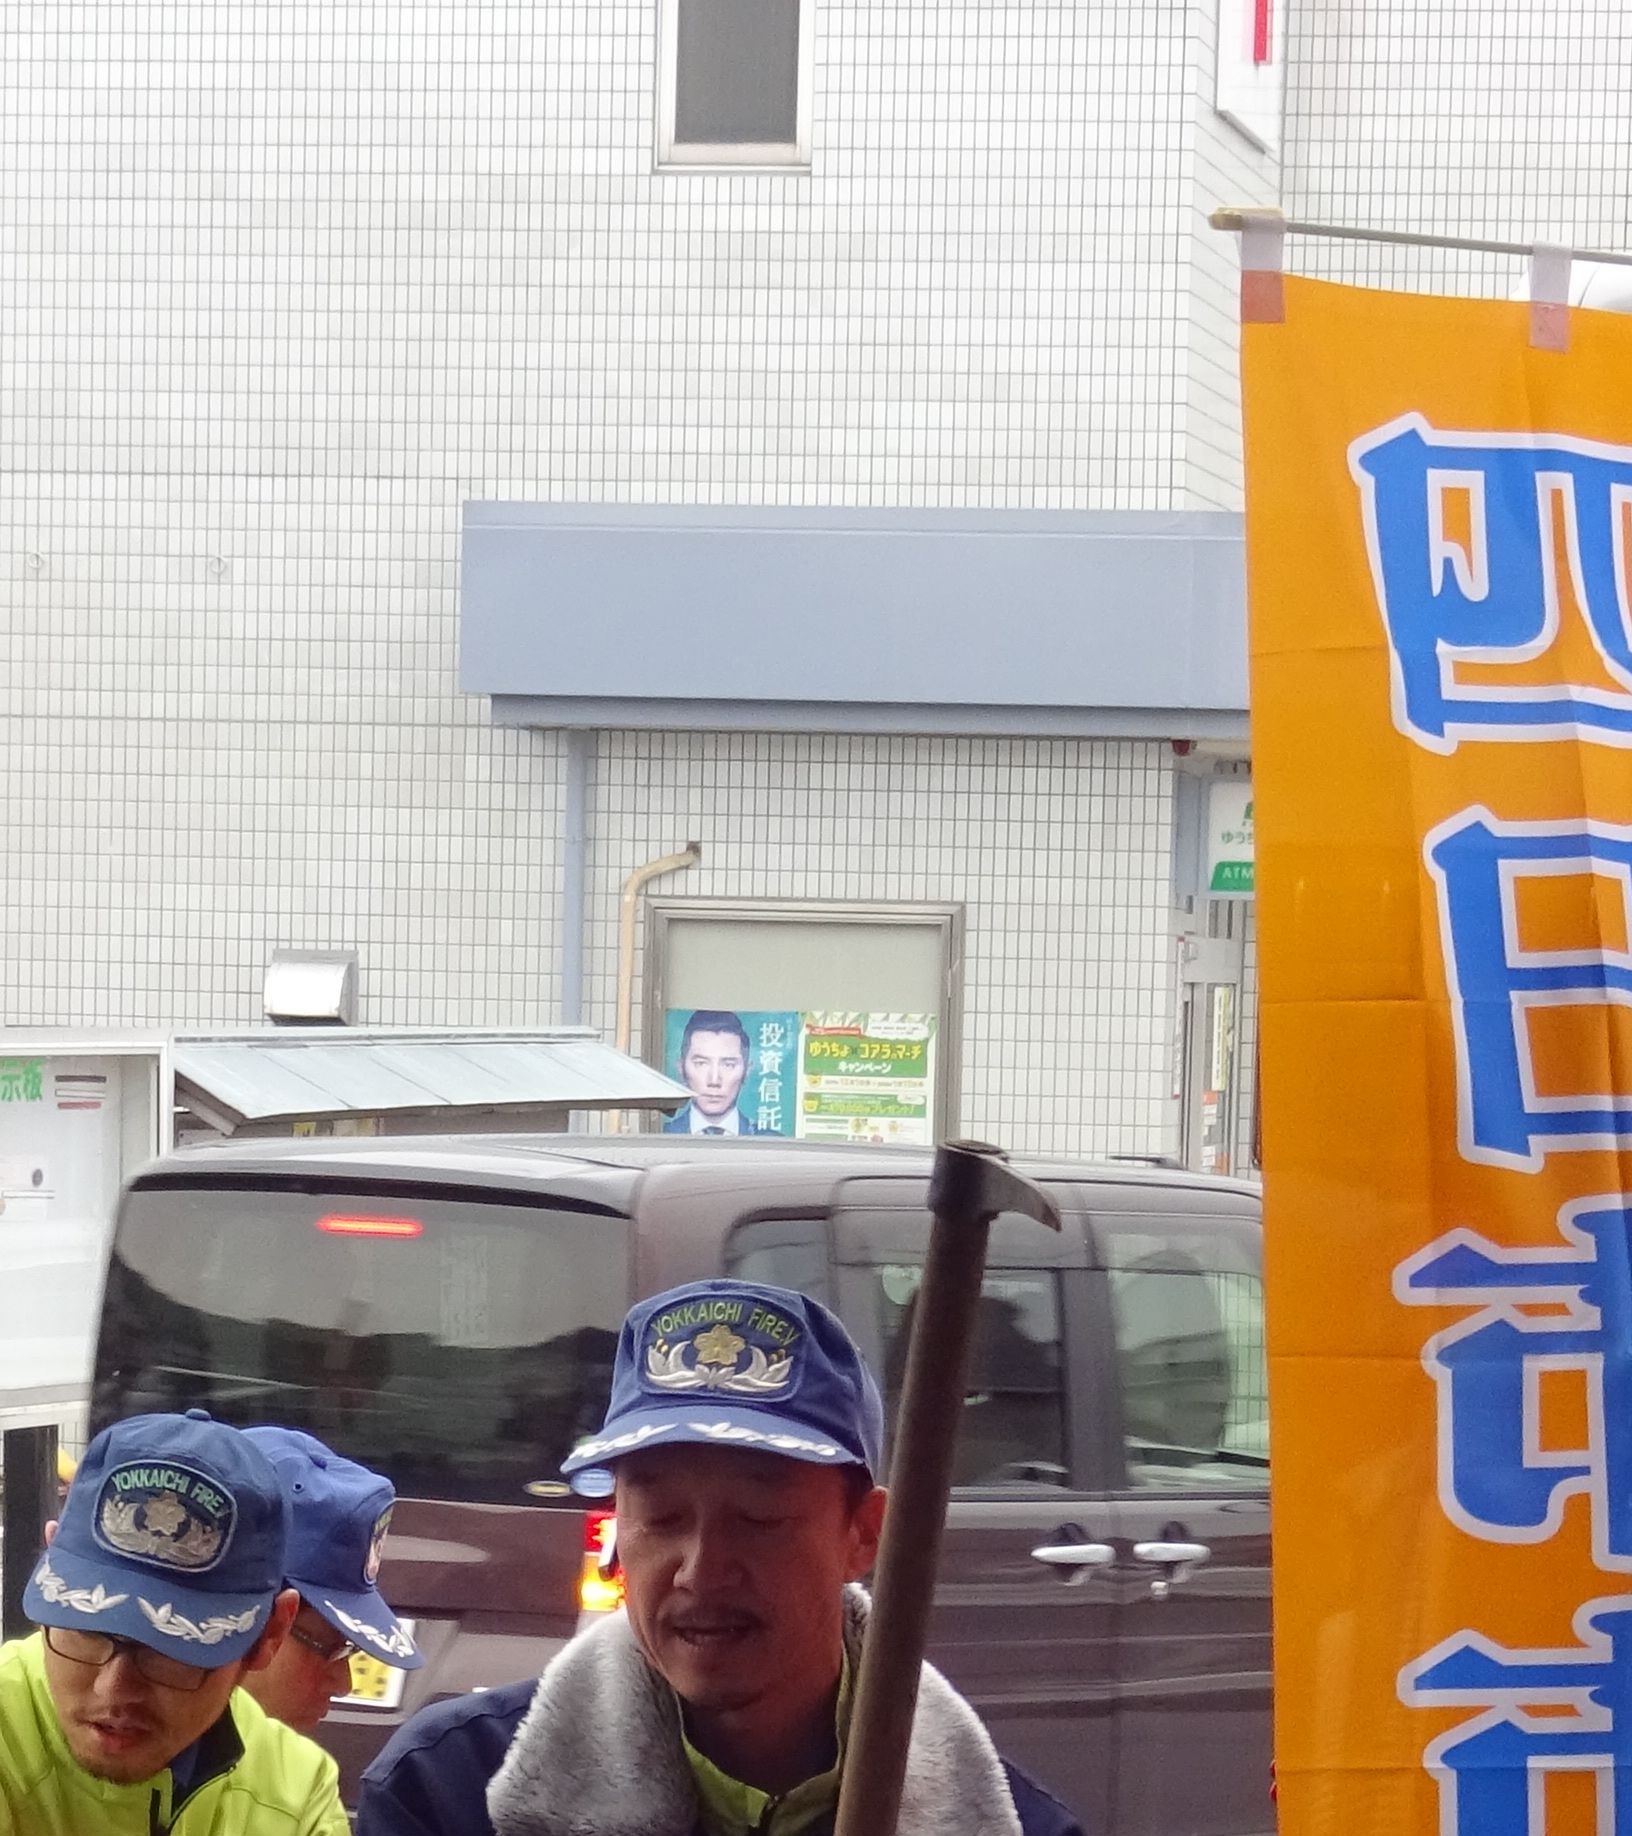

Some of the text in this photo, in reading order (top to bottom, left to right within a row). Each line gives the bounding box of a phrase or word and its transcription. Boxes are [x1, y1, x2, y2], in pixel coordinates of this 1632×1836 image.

[757, 1022, 784, 1131] 投資信託
[837, 1061, 892, 1073] キャンペーン
[650, 1302, 744, 1338] YOKKAICHI
[111, 1468, 191, 1494] YOKKAICHI
